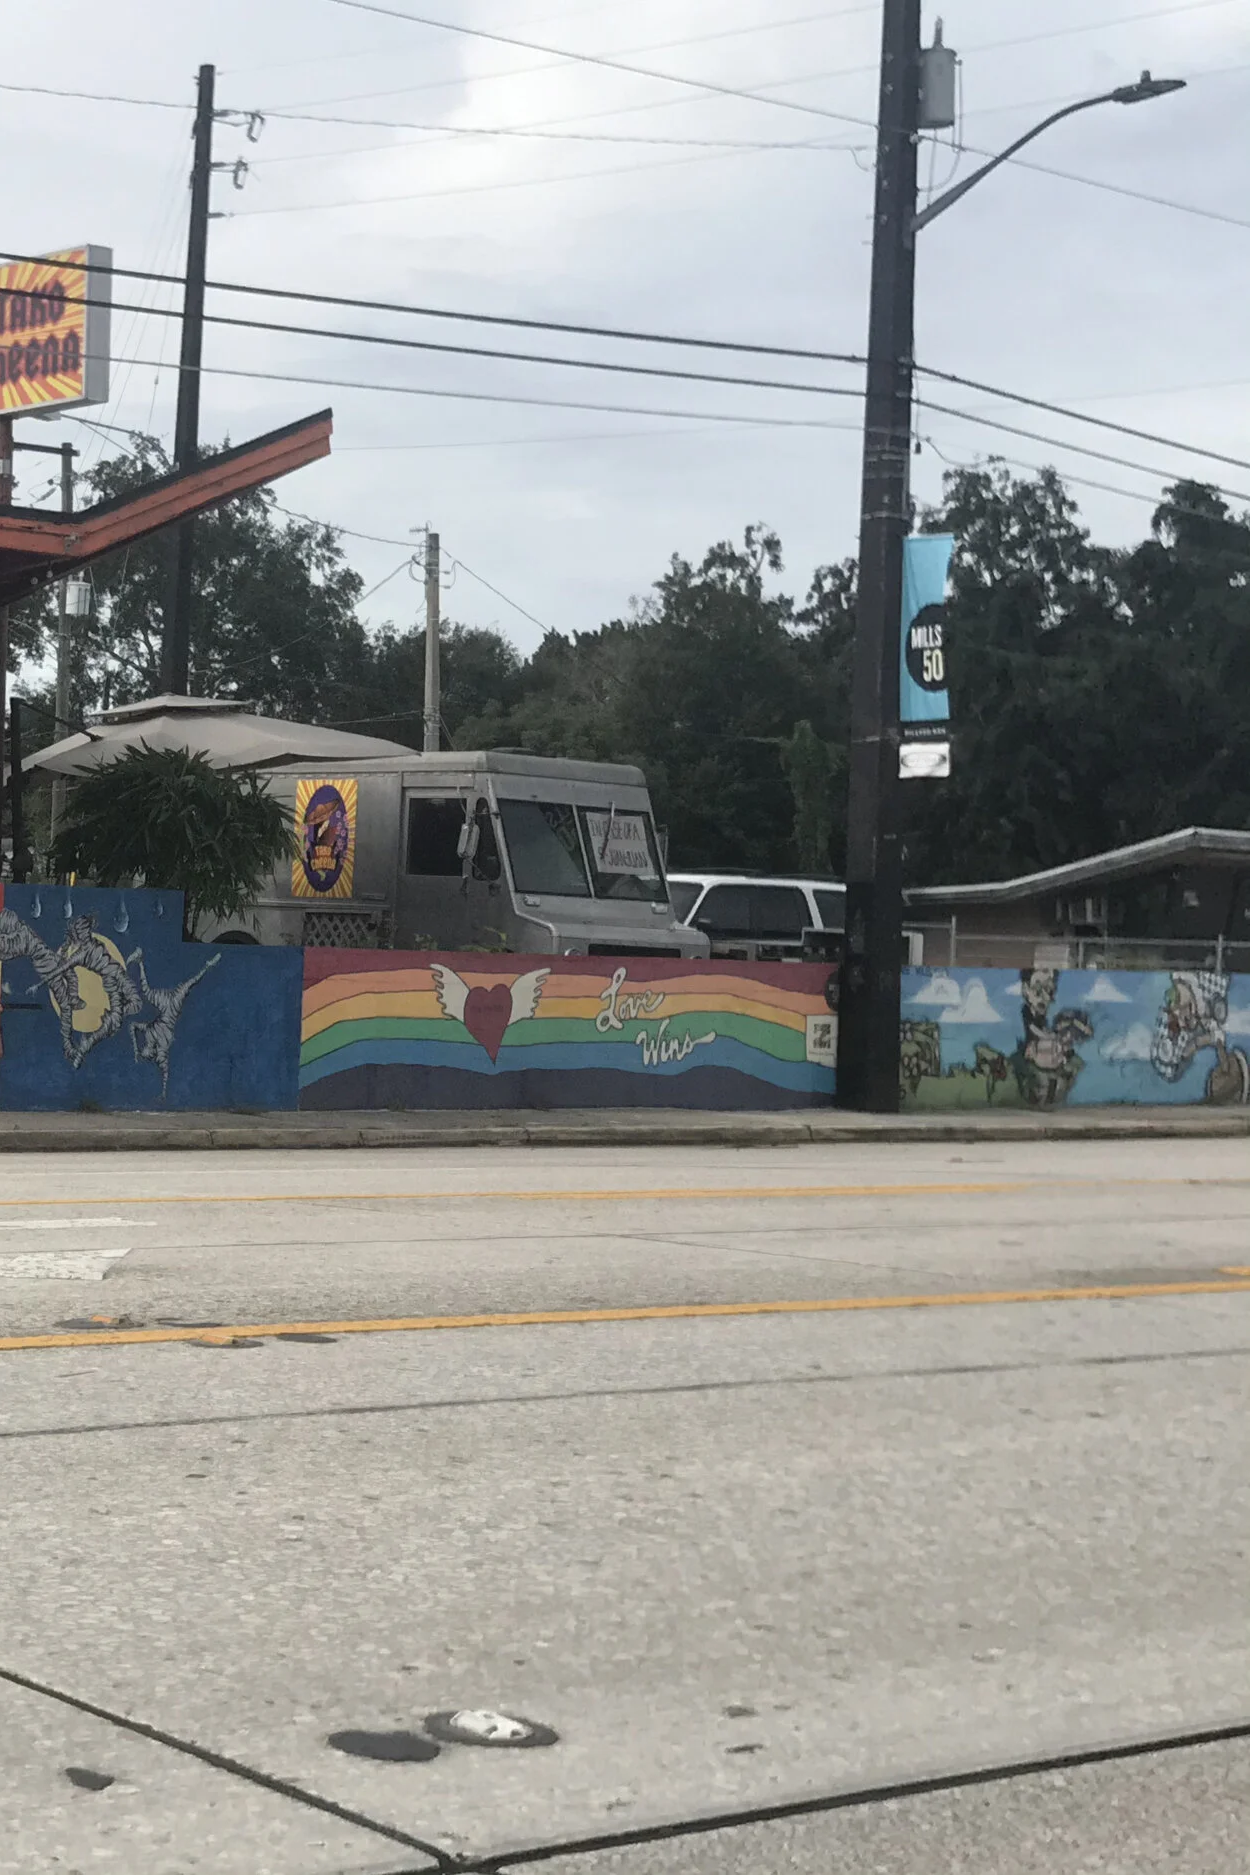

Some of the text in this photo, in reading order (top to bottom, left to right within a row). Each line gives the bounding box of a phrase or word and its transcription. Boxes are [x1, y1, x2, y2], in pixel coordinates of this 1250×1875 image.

[910, 625, 942, 650] MILLS
[923, 649, 944, 682] 50
[596, 966, 665, 1032] Love
[635, 1017, 716, 1066] Wins
